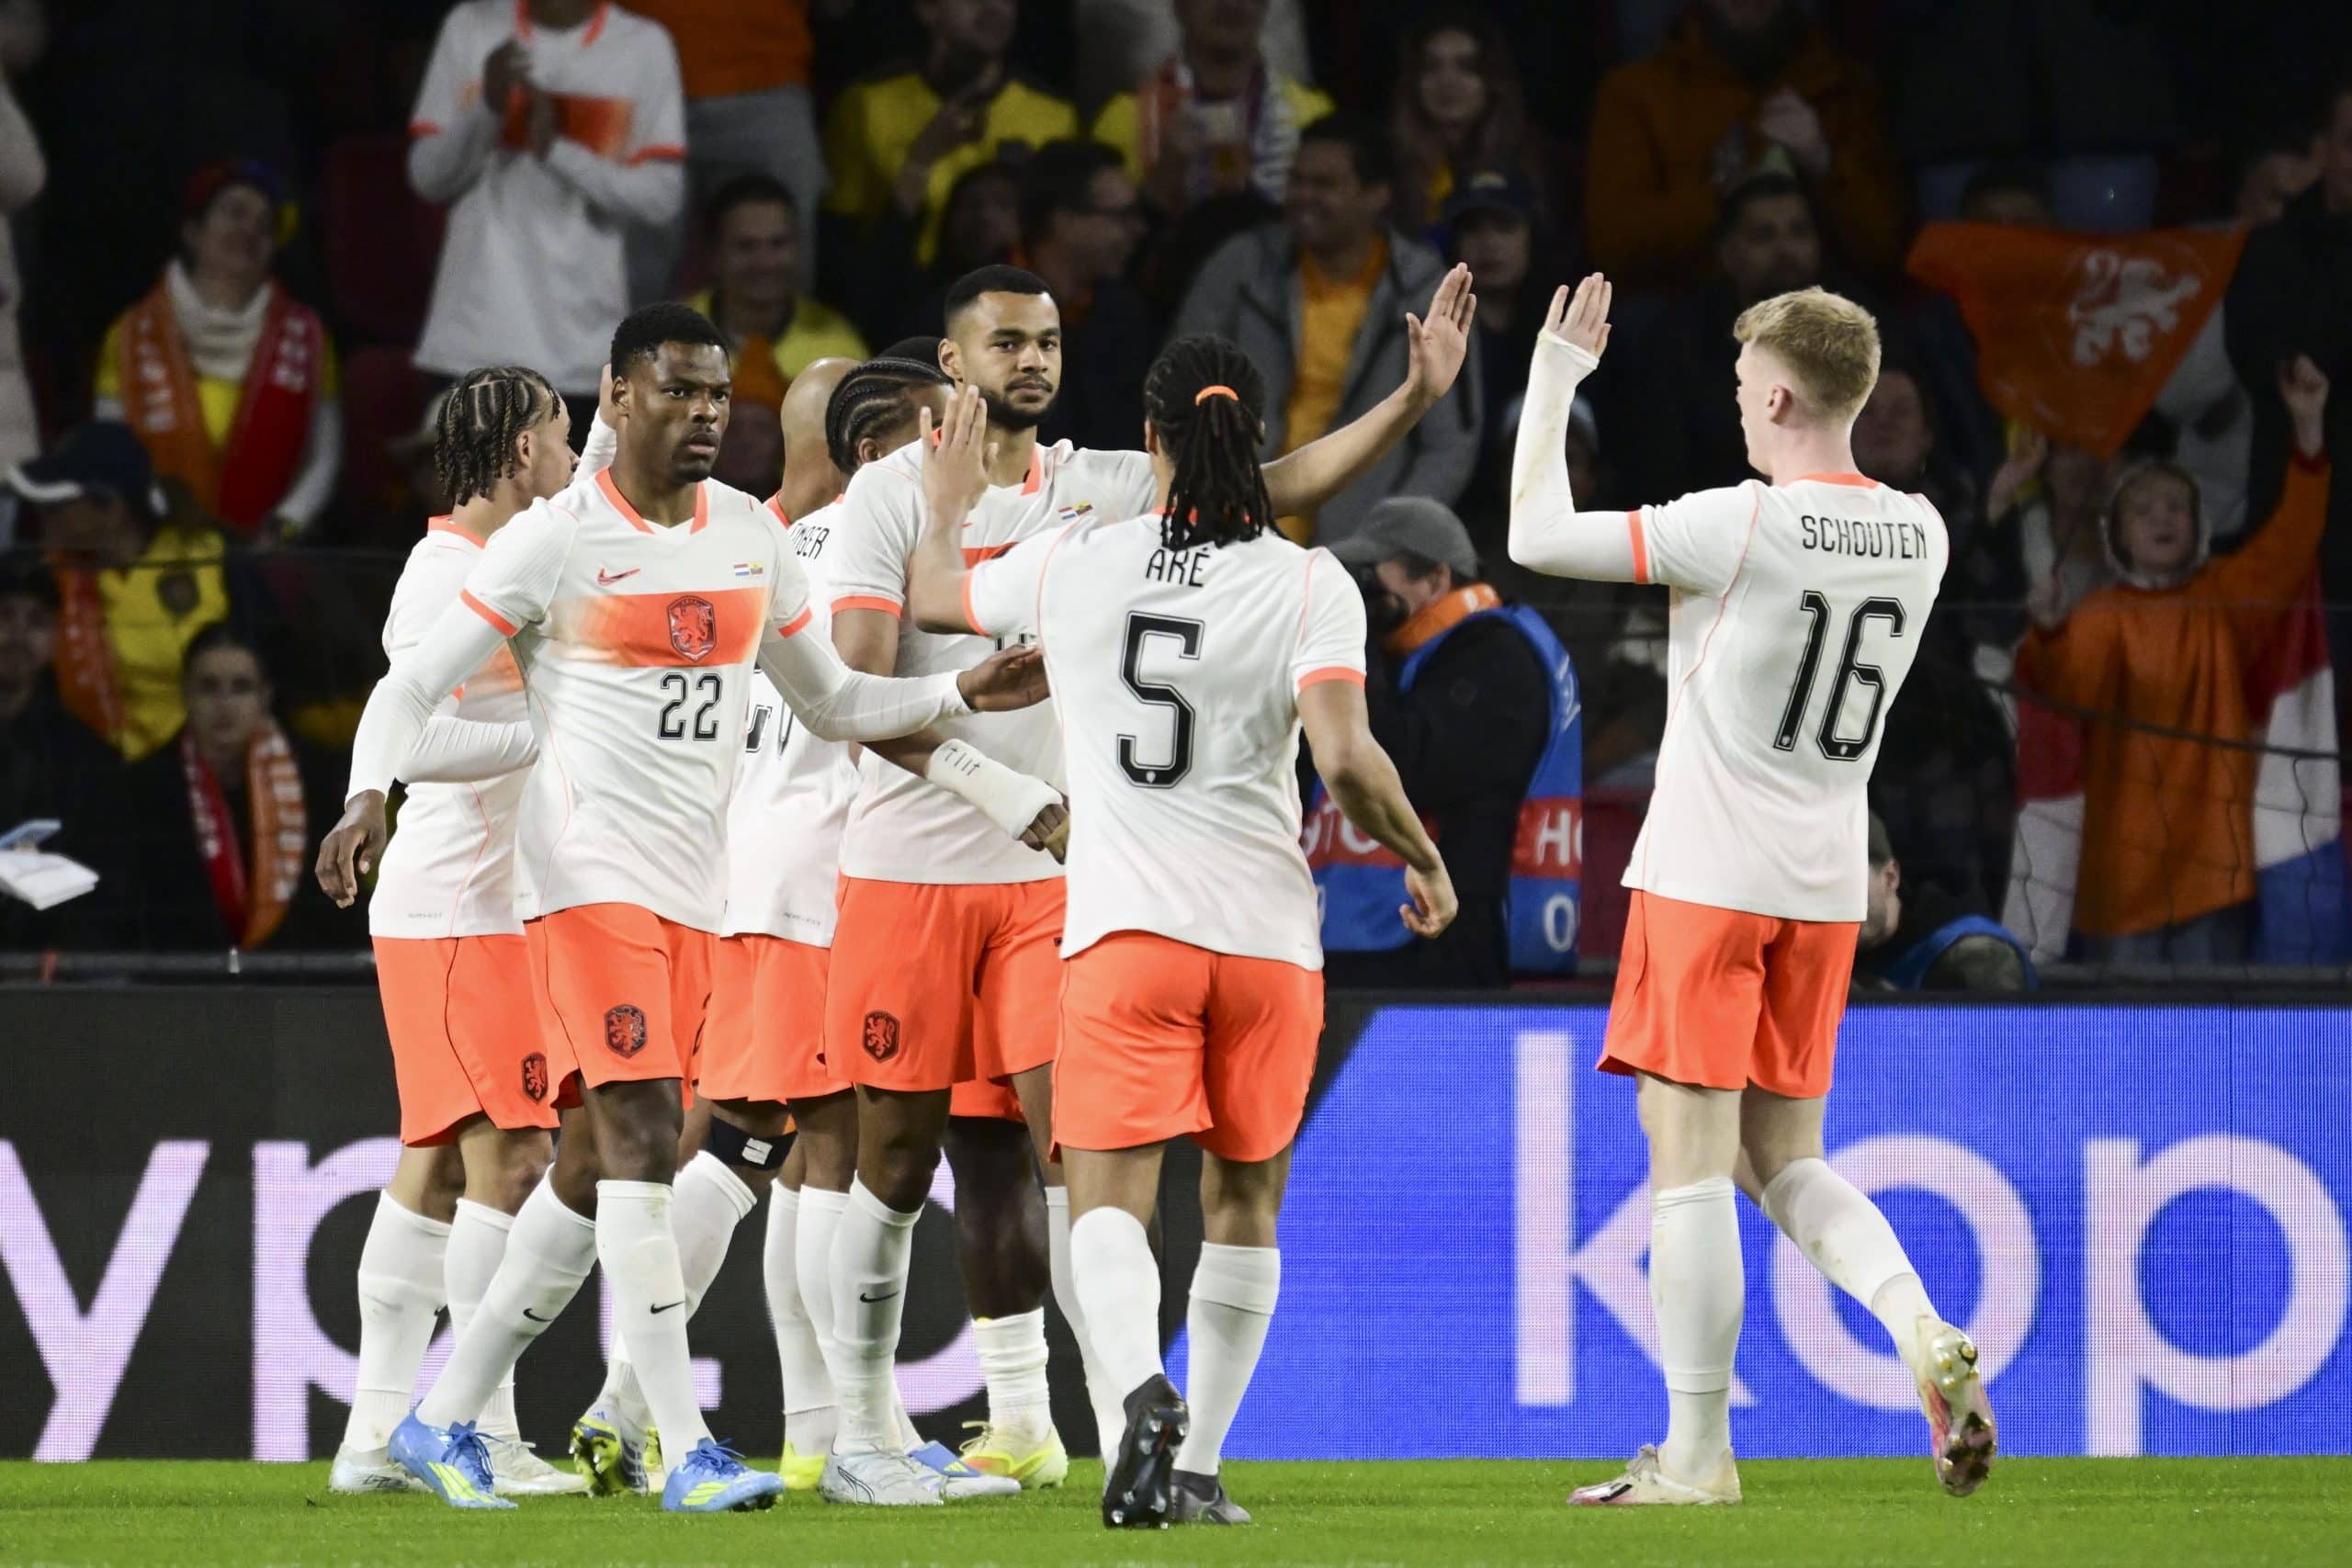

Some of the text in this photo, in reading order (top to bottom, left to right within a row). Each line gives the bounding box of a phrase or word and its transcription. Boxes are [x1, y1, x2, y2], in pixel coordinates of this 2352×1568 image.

[1801, 514, 1928, 559] SCHOUTEN
[658, 672, 723, 741] 22
[1116, 610, 1205, 789] 5
[1773, 589, 1906, 761] 16
[1515, 1031, 2350, 1457] kop
